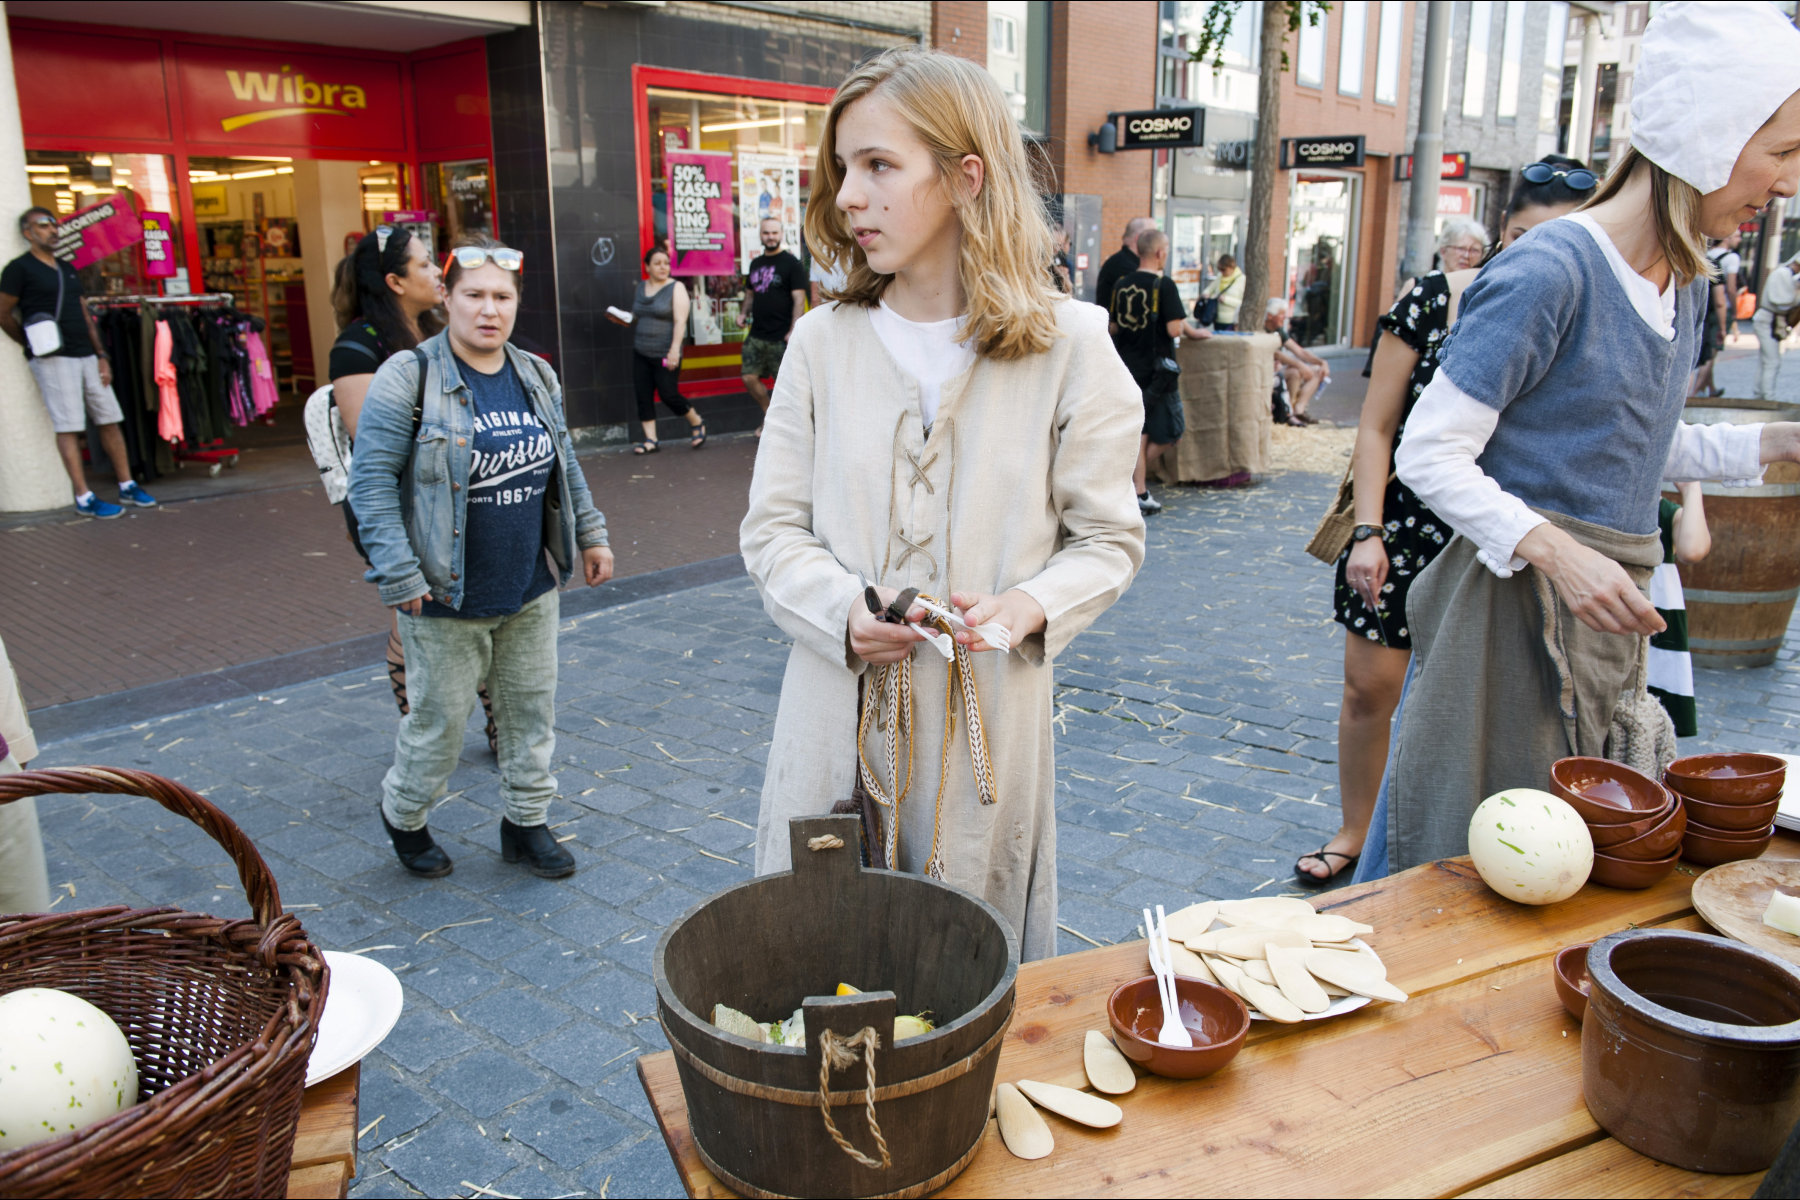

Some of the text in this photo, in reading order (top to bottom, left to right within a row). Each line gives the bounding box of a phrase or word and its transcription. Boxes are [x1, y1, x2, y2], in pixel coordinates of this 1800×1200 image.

[225, 64, 367, 108] Wibra
[1129, 116, 1191, 134] COSMO
[1299, 142, 1355, 156] COSMO
[673, 165, 706, 182] 50%
[673, 181, 720, 198] KASSA
[674, 196, 706, 213] KOR
[57, 204, 115, 238] AKORTING
[674, 212, 709, 228] TING
[474, 411, 543, 433] RIGINAL
[492, 428, 522, 437] ATHLETIC
[496, 486, 532, 506] 1967
